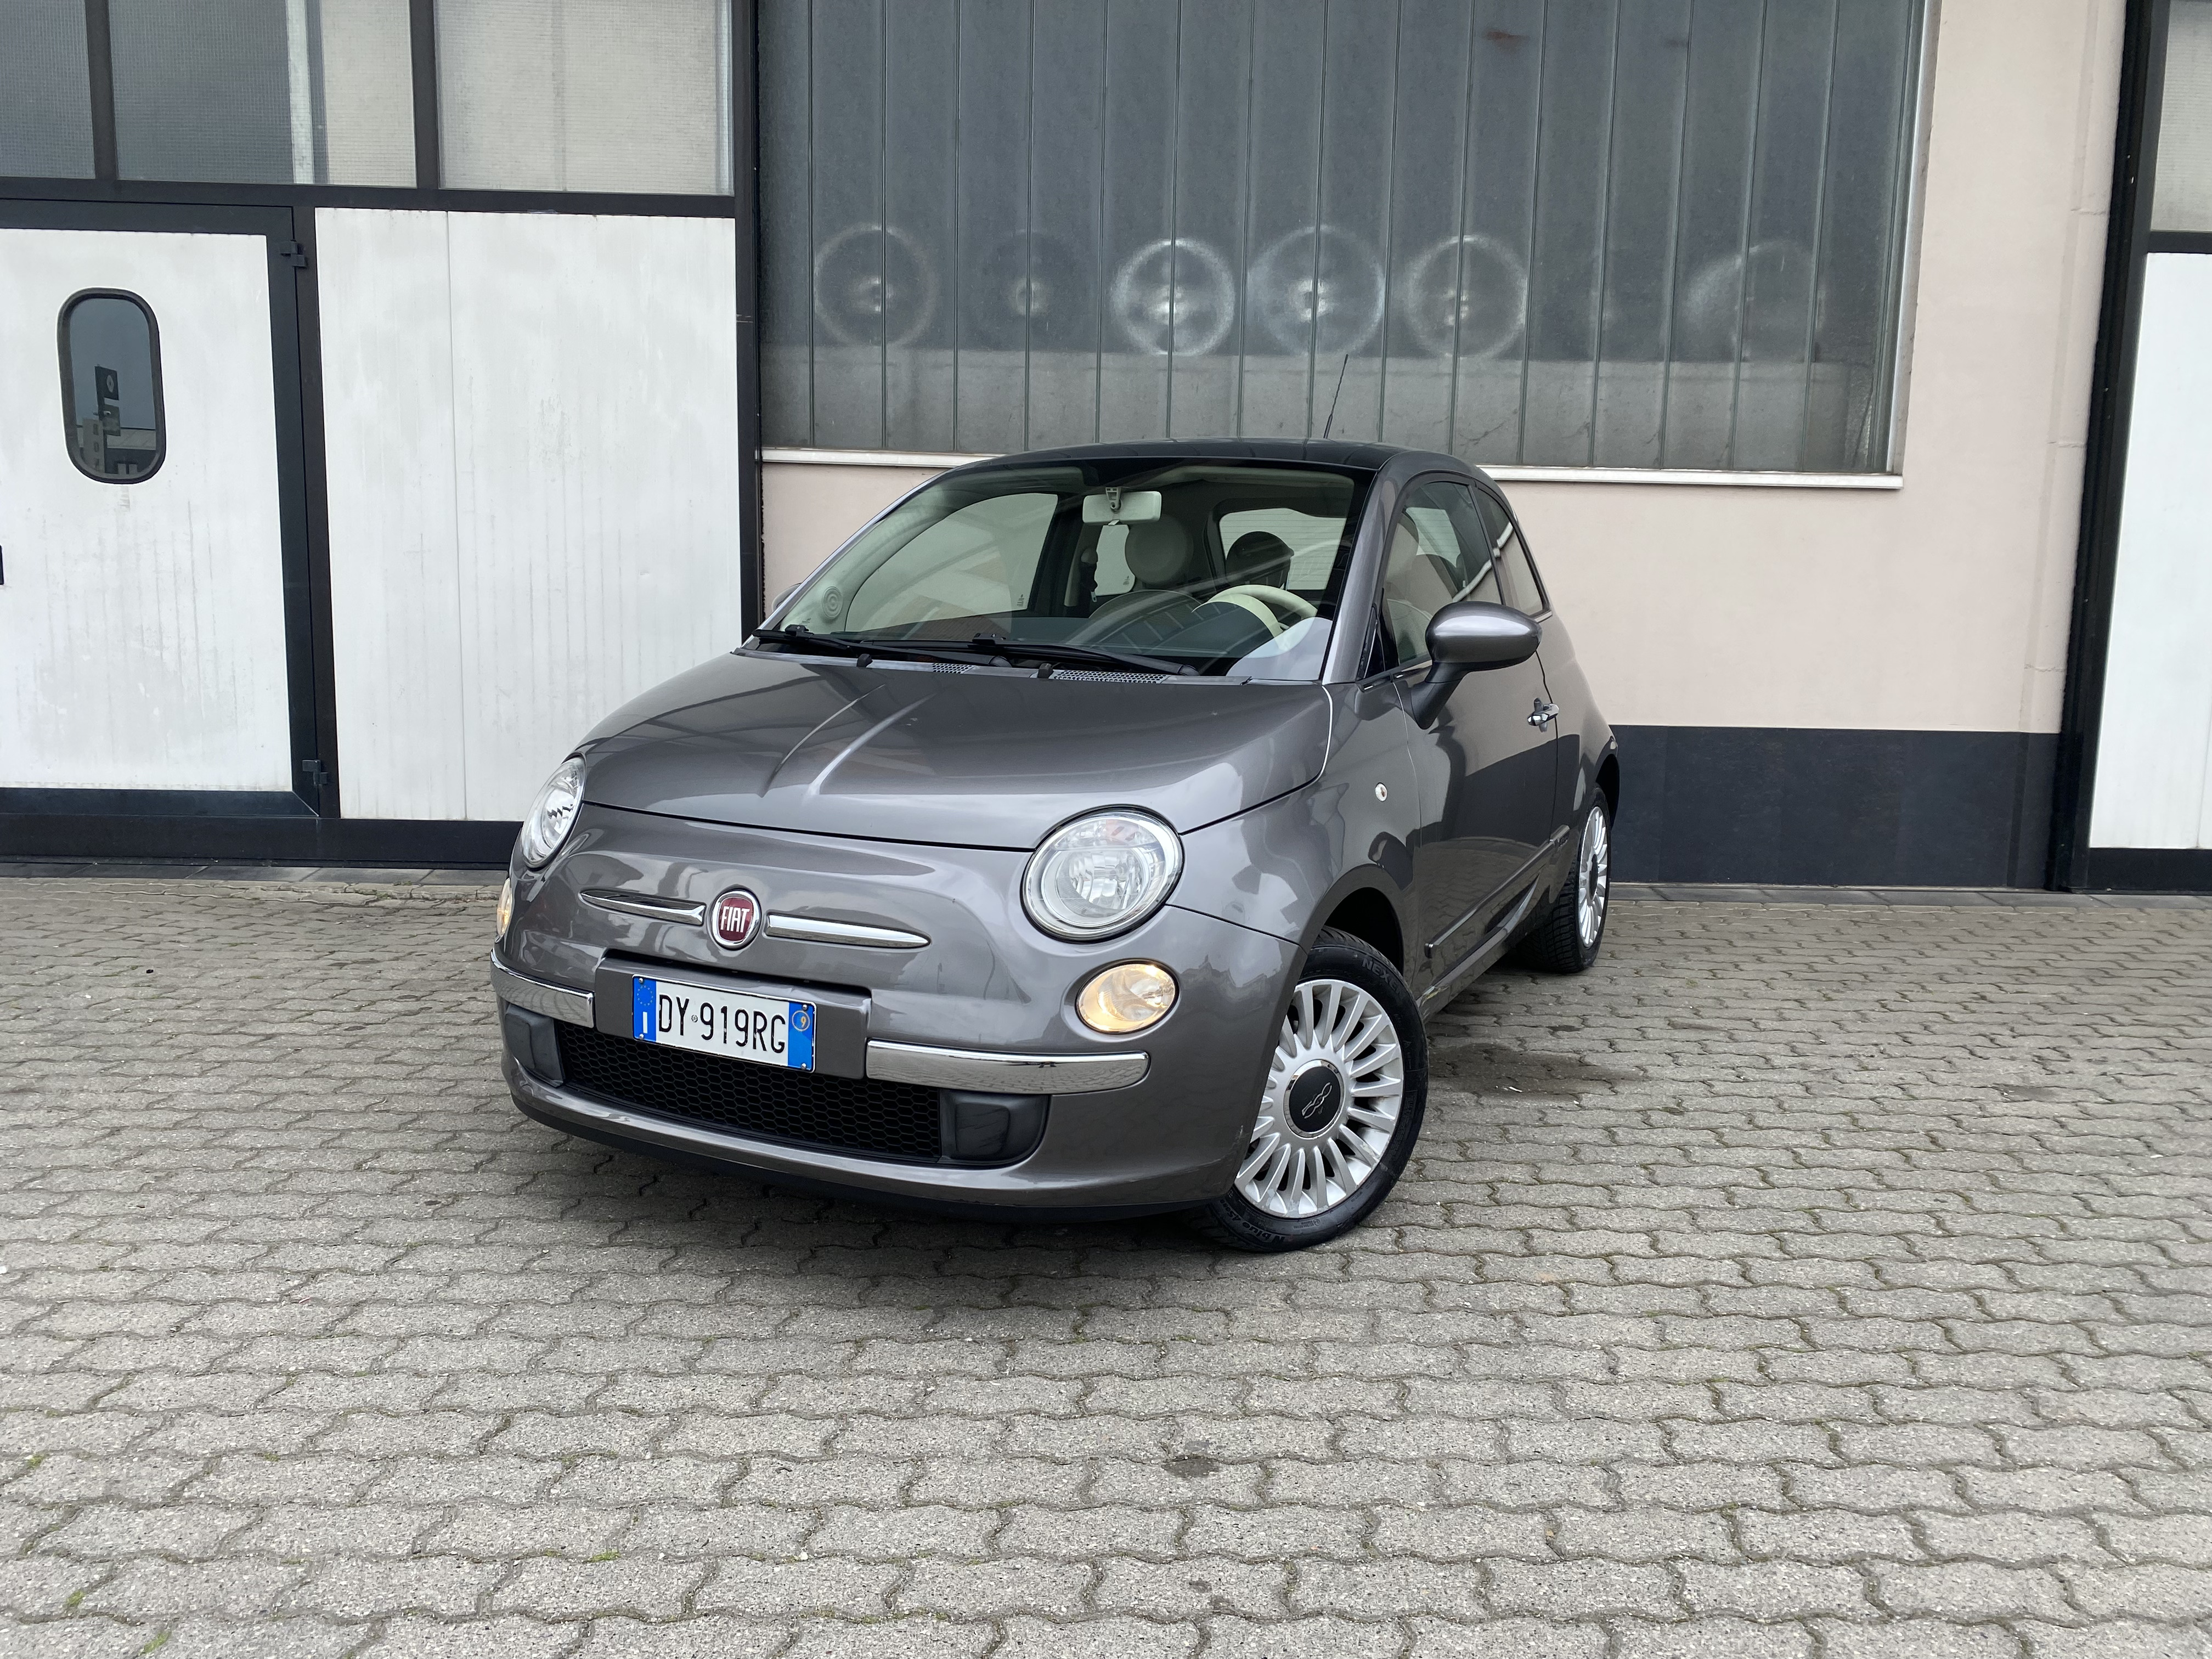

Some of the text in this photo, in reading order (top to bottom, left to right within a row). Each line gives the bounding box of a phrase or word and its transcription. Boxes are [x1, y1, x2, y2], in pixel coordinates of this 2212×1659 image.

[721, 906, 750, 933] FIAT
[659, 995, 786, 1054] DY 919RG
